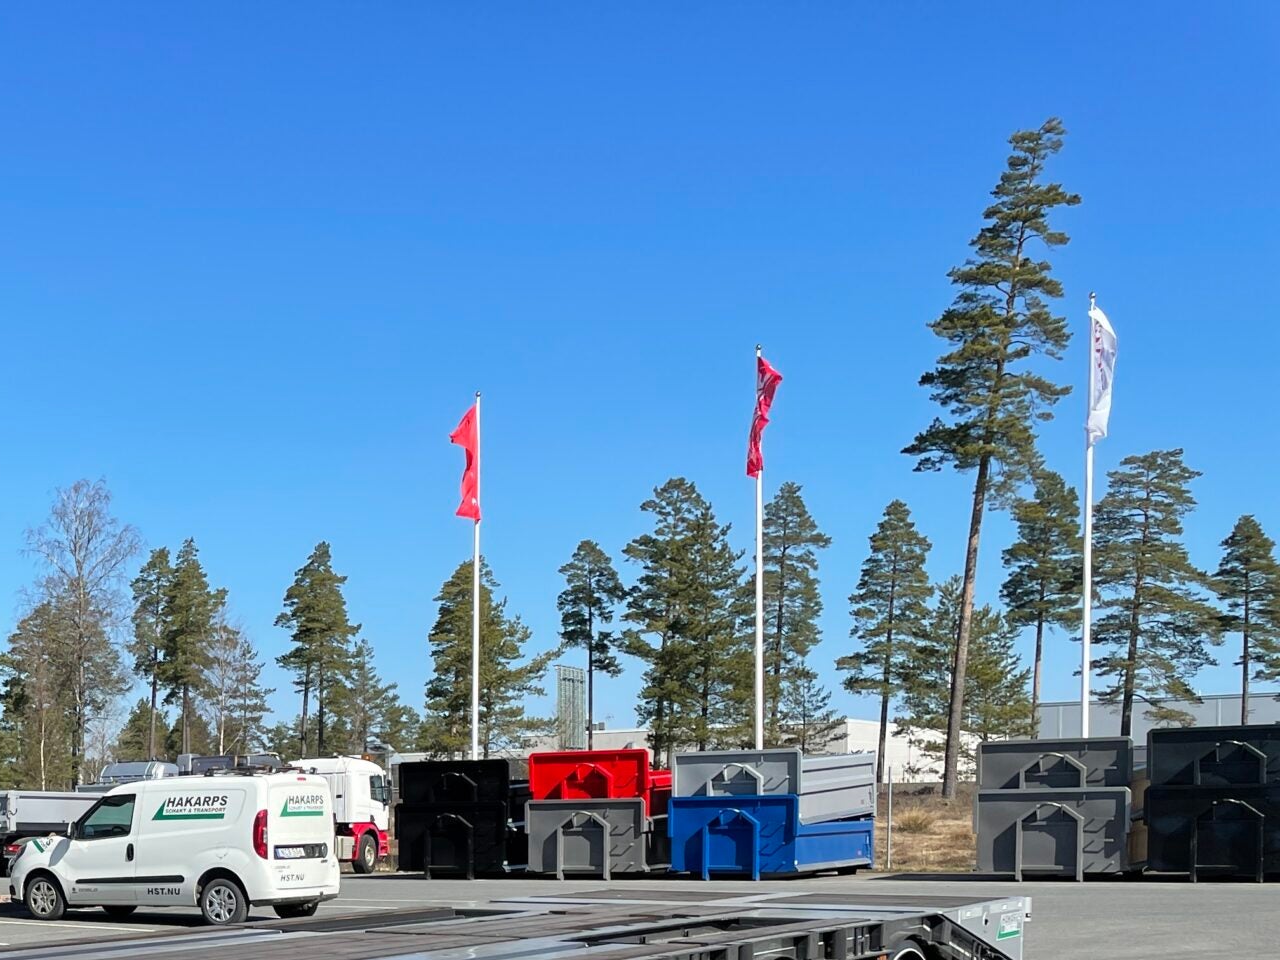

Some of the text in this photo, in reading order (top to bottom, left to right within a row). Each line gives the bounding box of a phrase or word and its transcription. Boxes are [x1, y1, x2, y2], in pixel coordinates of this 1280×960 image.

[166, 795, 229, 807] HAKARPS
[288, 795, 324, 805] HAKARPS
[147, 887, 181, 896] HST.NU
